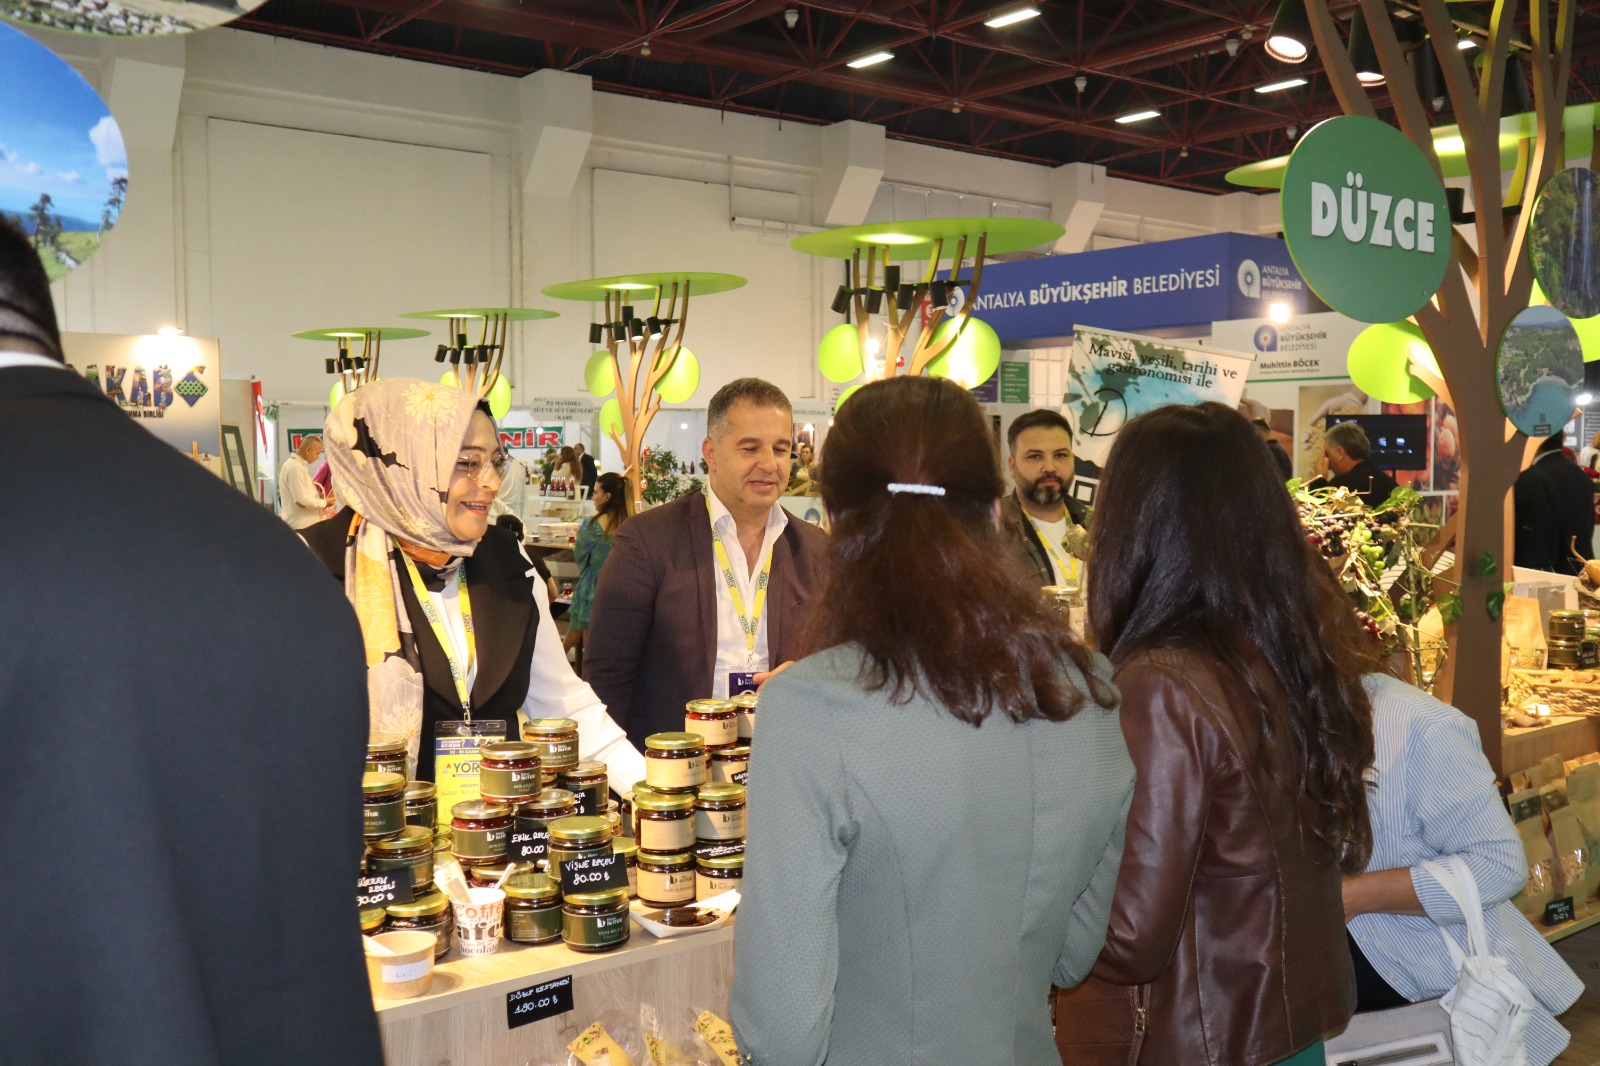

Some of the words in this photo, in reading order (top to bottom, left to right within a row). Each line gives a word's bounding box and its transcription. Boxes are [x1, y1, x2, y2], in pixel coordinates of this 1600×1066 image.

[1311, 171, 1435, 253] DÜZCE
[1262, 265, 1290, 276] ANTALYA
[1029, 276, 1129, 305] BÜYÜKŞEHİR
[1133, 264, 1220, 295] BELEDİYESİ
[1262, 277, 1302, 290] BÜYÜKŞEHİR
[1280, 332, 1328, 342] BÜYÜKŞEHİR
[1280, 343, 1317, 352] BELEDİYESİ
[1089, 343, 1135, 362] Mavisi,
[1140, 353, 1177, 370] yeşili,
[1181, 361, 1218, 376] tarihi
[1222, 369, 1238, 379] ve
[1260, 361, 1292, 369] Muhittin
[1293, 358, 1320, 367] BÖCEK
[1107, 362, 1192, 384] gastronomisi
[1196, 374, 1213, 388] ile
[66, 363, 174, 410] AKAB
[143, 410, 164, 418] BİRLİĞİ
[424, 599, 440, 623] YOREX
[511, 833, 532, 843] ERİK
[521, 845, 545, 856] 80.00
[565, 860, 590, 871] VİŞNE
[592, 855, 616, 867] REÇELİ
[573, 872, 602, 885] 80.00
